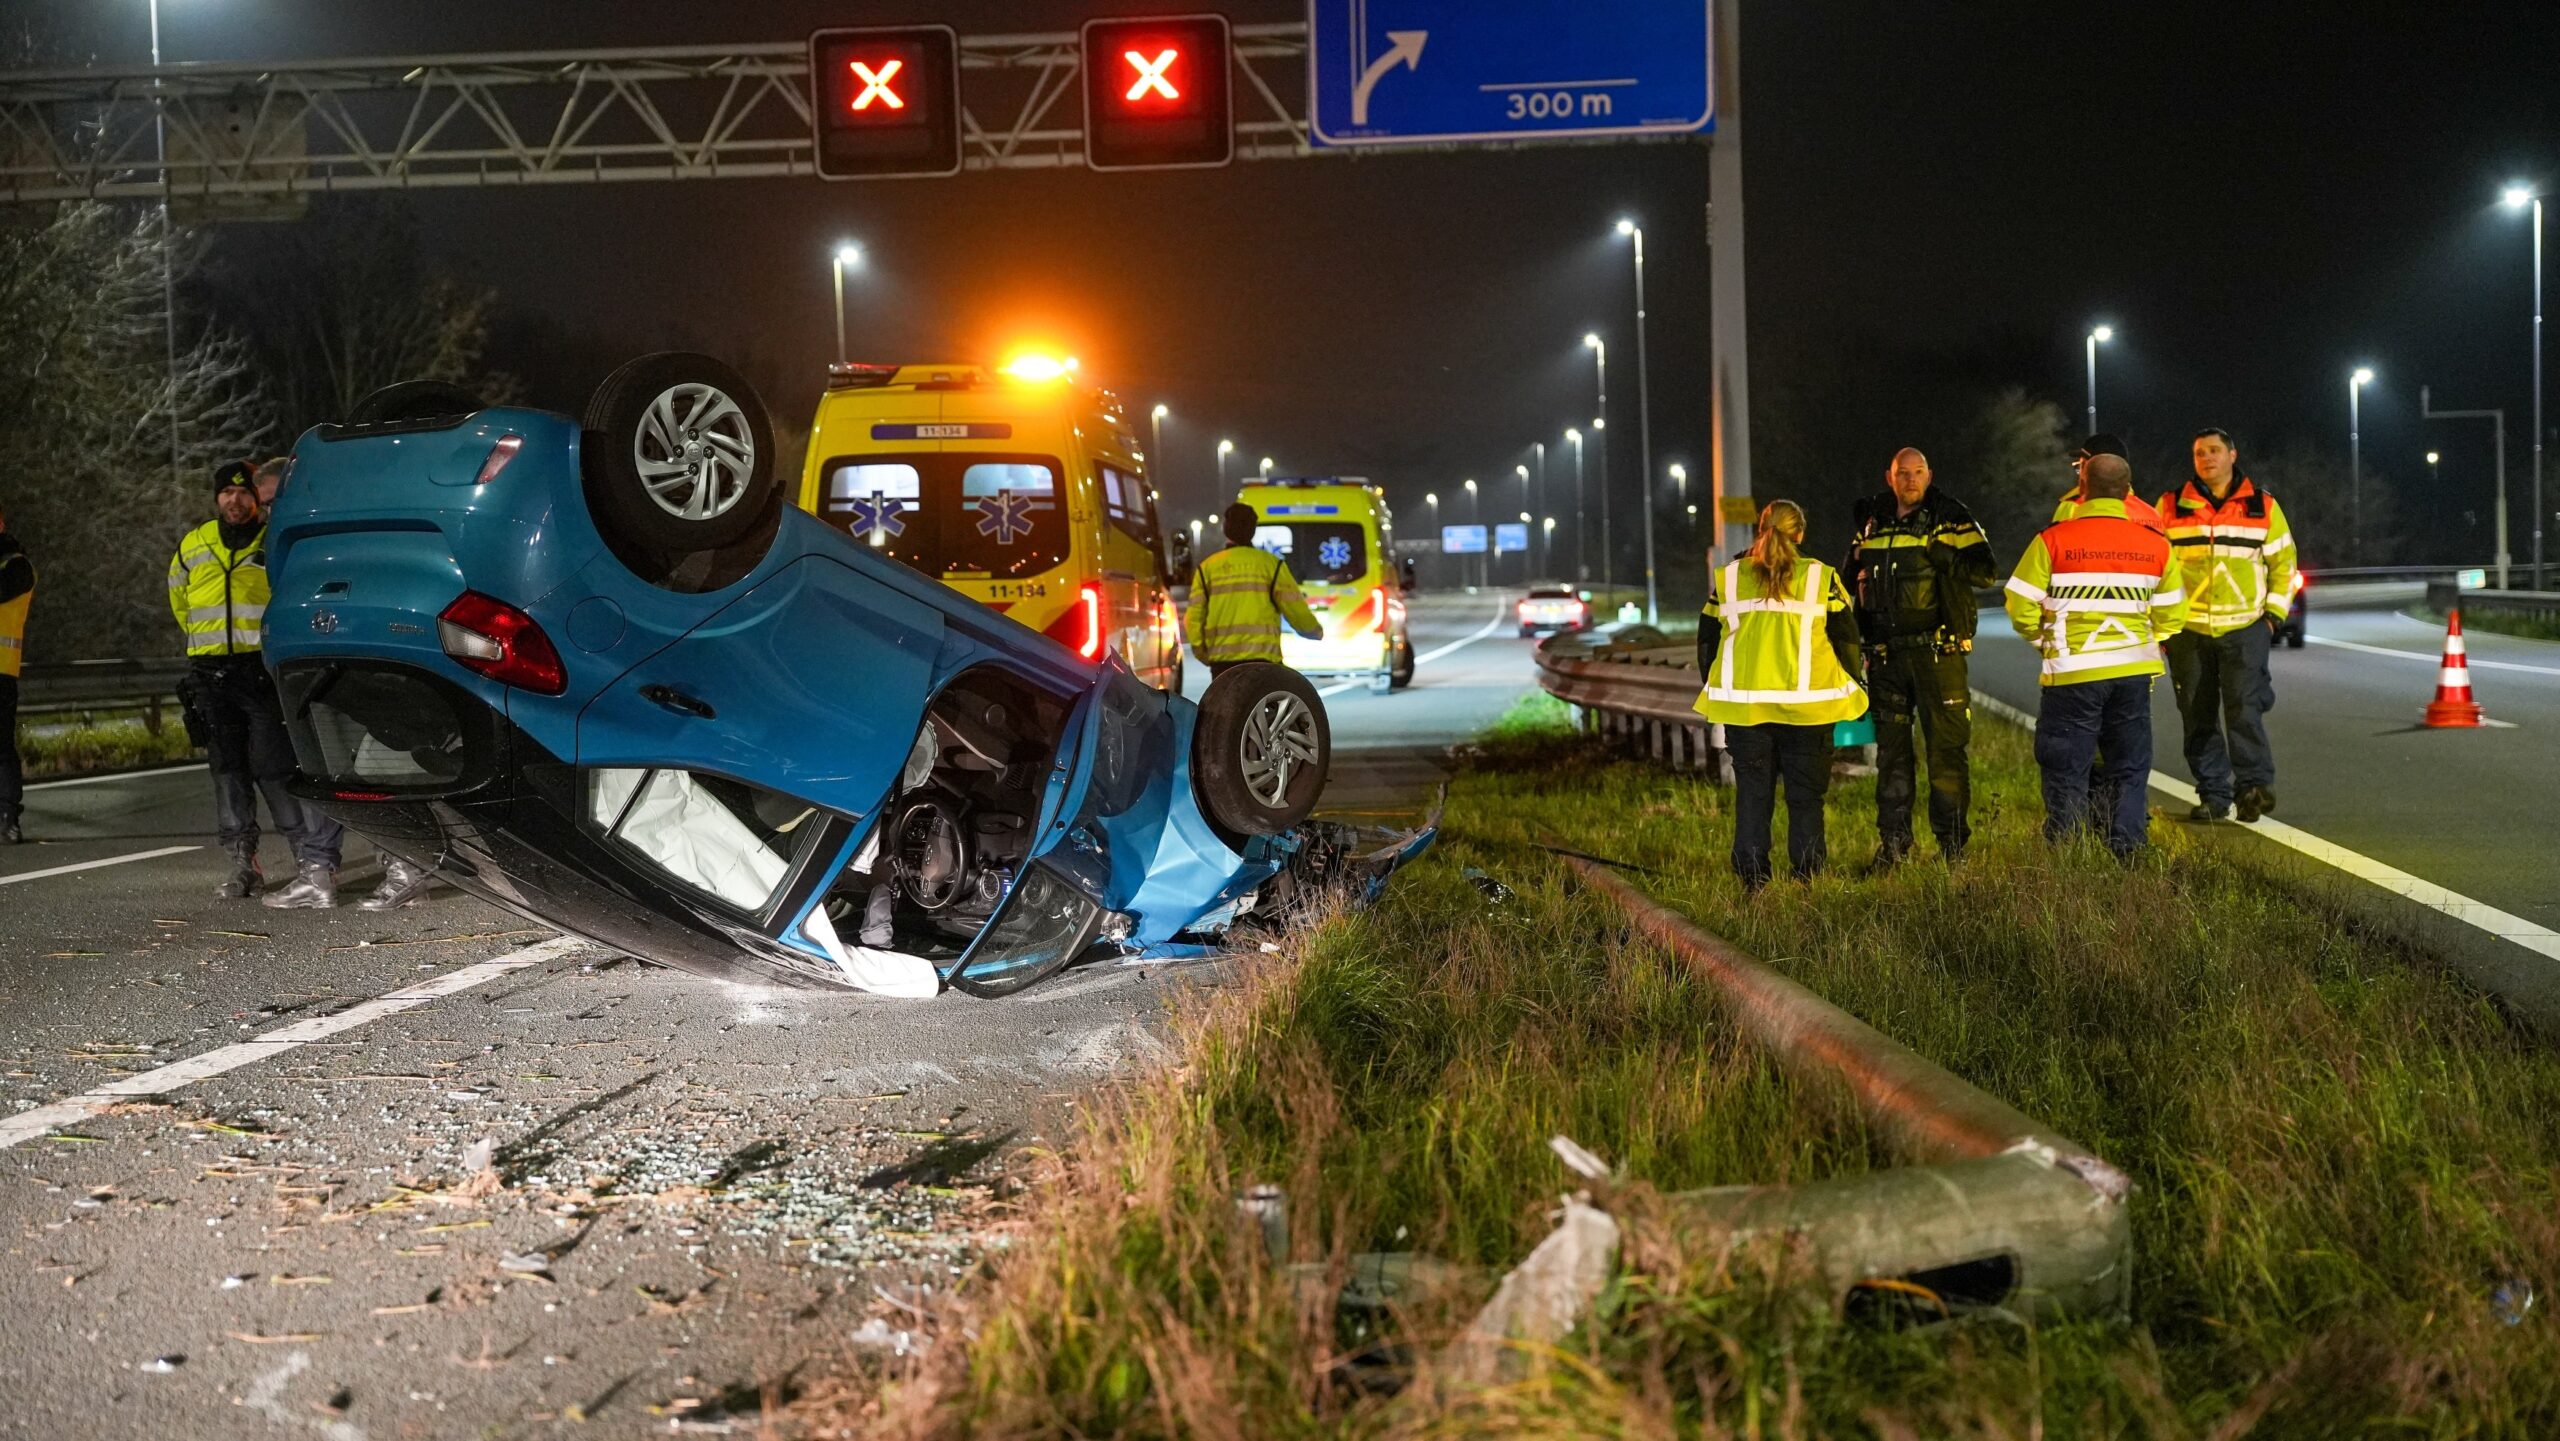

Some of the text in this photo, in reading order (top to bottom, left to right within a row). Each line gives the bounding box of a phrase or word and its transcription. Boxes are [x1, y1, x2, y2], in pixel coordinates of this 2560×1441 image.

[1506, 92, 1612, 119] 300 m
[2064, 548, 2156, 563] Rijkswaterstaat
[988, 584, 1046, 598] 11-134
